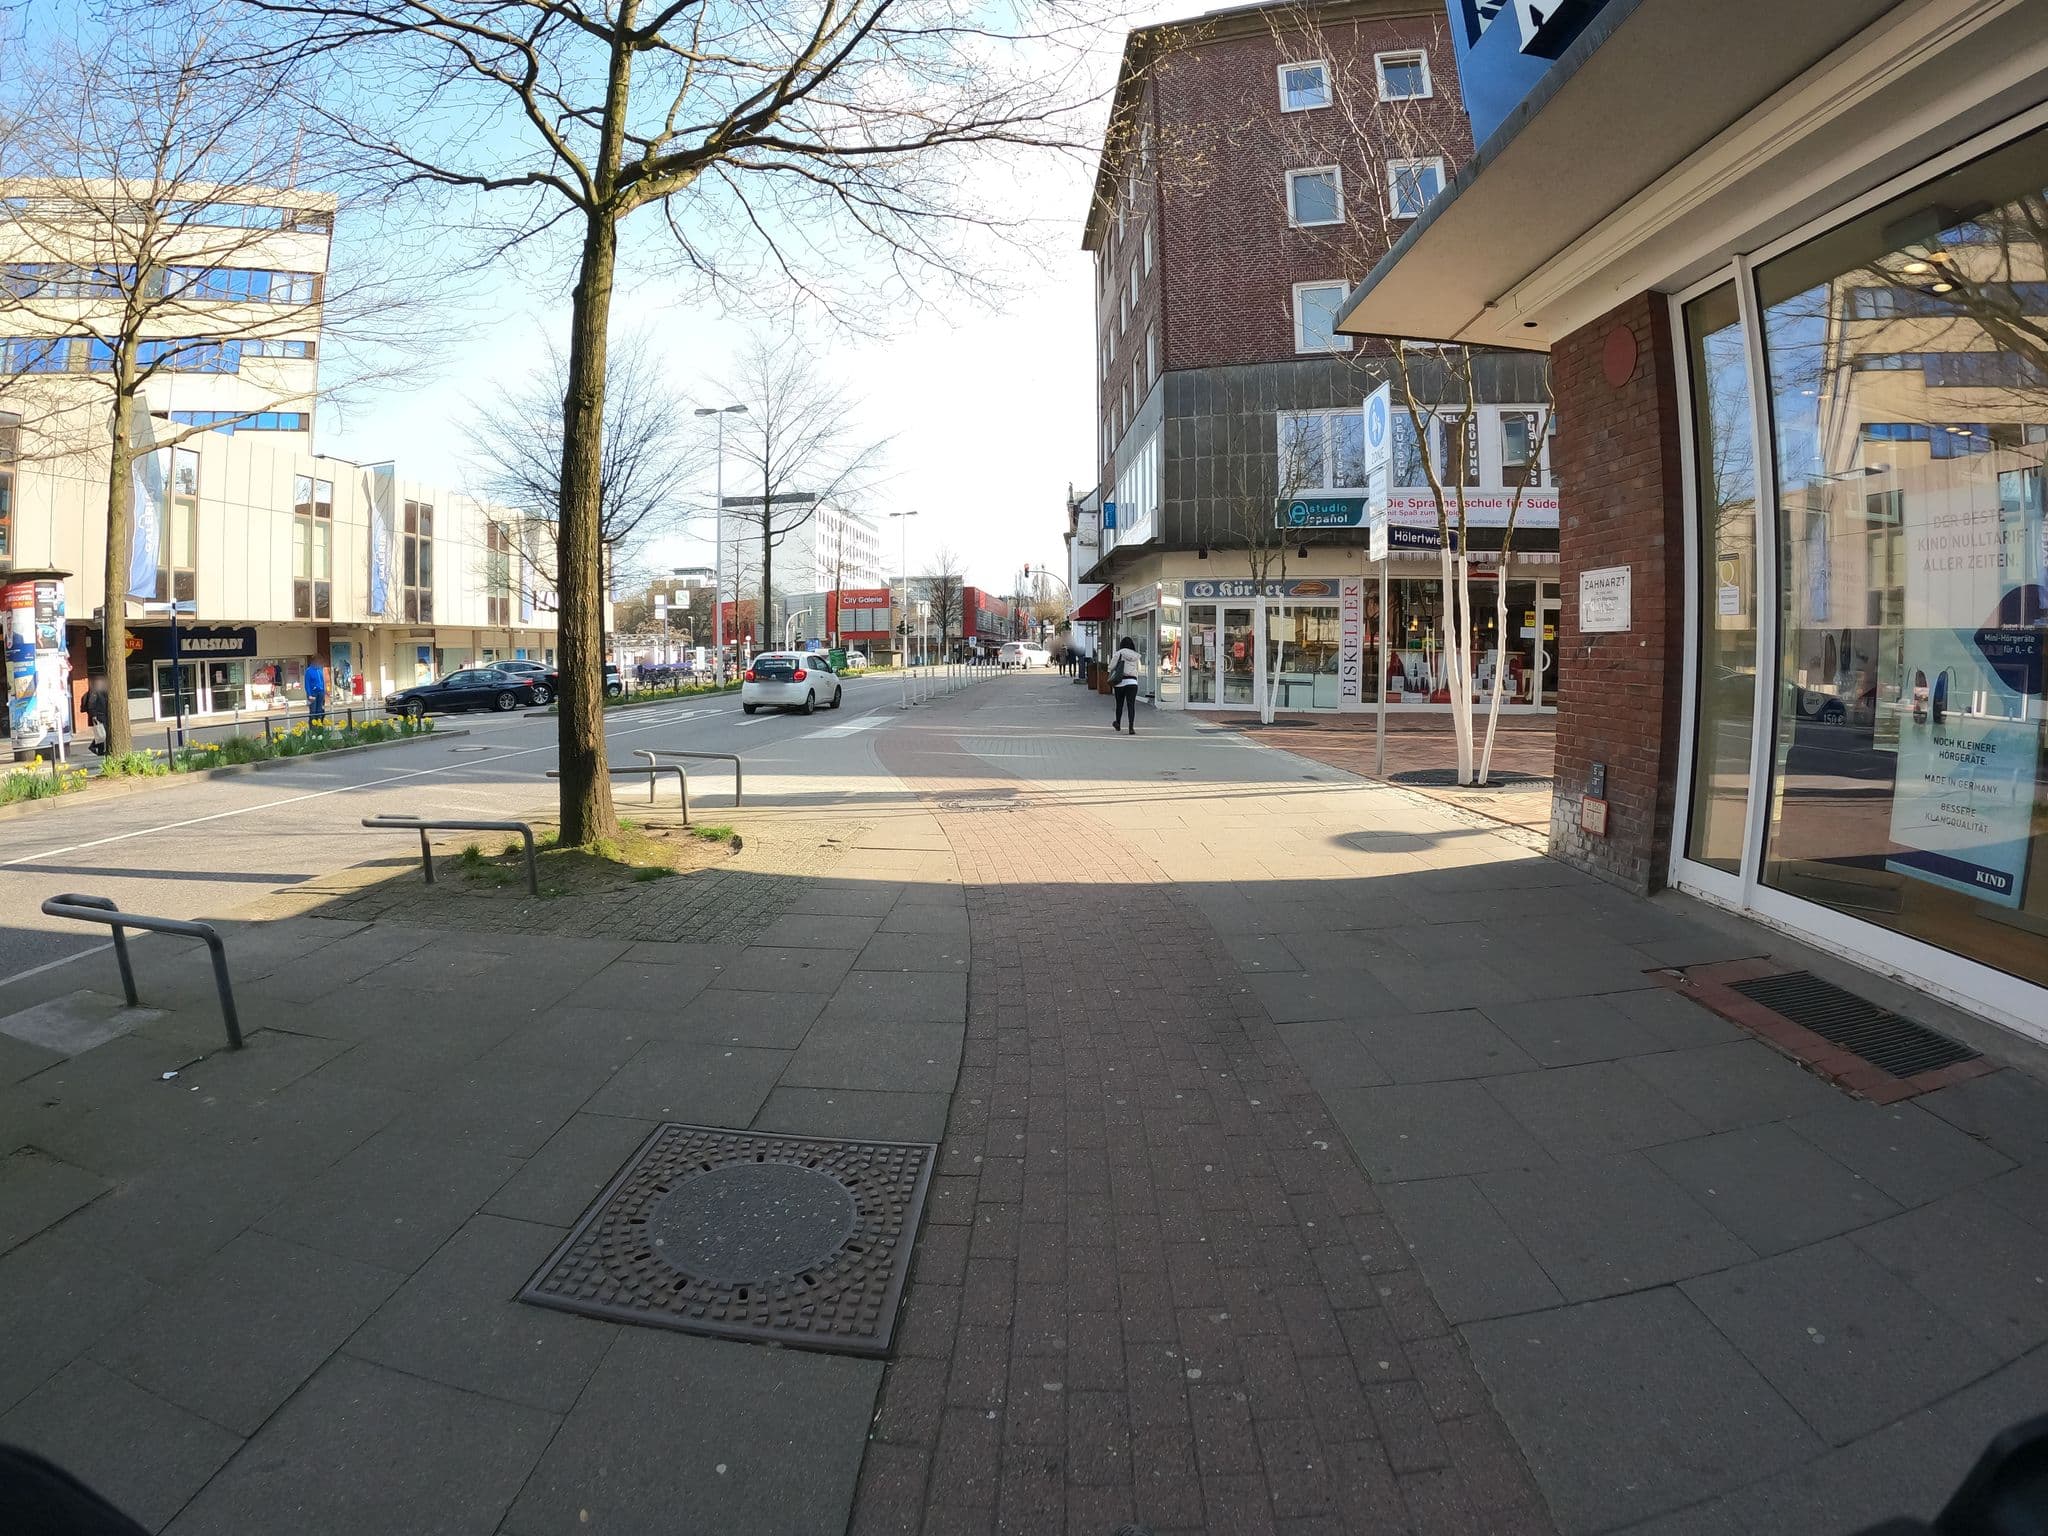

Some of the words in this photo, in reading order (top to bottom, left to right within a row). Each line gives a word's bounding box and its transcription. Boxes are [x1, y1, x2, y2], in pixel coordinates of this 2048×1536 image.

[1395, 416, 1406, 477] DEUTSCH
[1527, 498, 1560, 509] Süde
[1961, 507, 2006, 526] BESTE
[1918, 535, 1948, 551] KIND
[1923, 556, 1963, 572] ALLER
[1219, 581, 1284, 597] Körer
[1585, 576, 1625, 590] ZAHNARZT
[843, 596, 857, 605] City
[858, 596, 883, 604] Galerie
[181, 638, 244, 651] KARSTADT
[1342, 584, 1359, 698] EISKELLER
[2003, 645, 2014, 654] für
[1933, 736, 1955, 748] NOCH
[1957, 740, 1997, 754] KLEINERE
[1925, 773, 1946, 785] MADE
[1940, 802, 1977, 818] BESSERE
[1976, 870, 2007, 889] KIND
